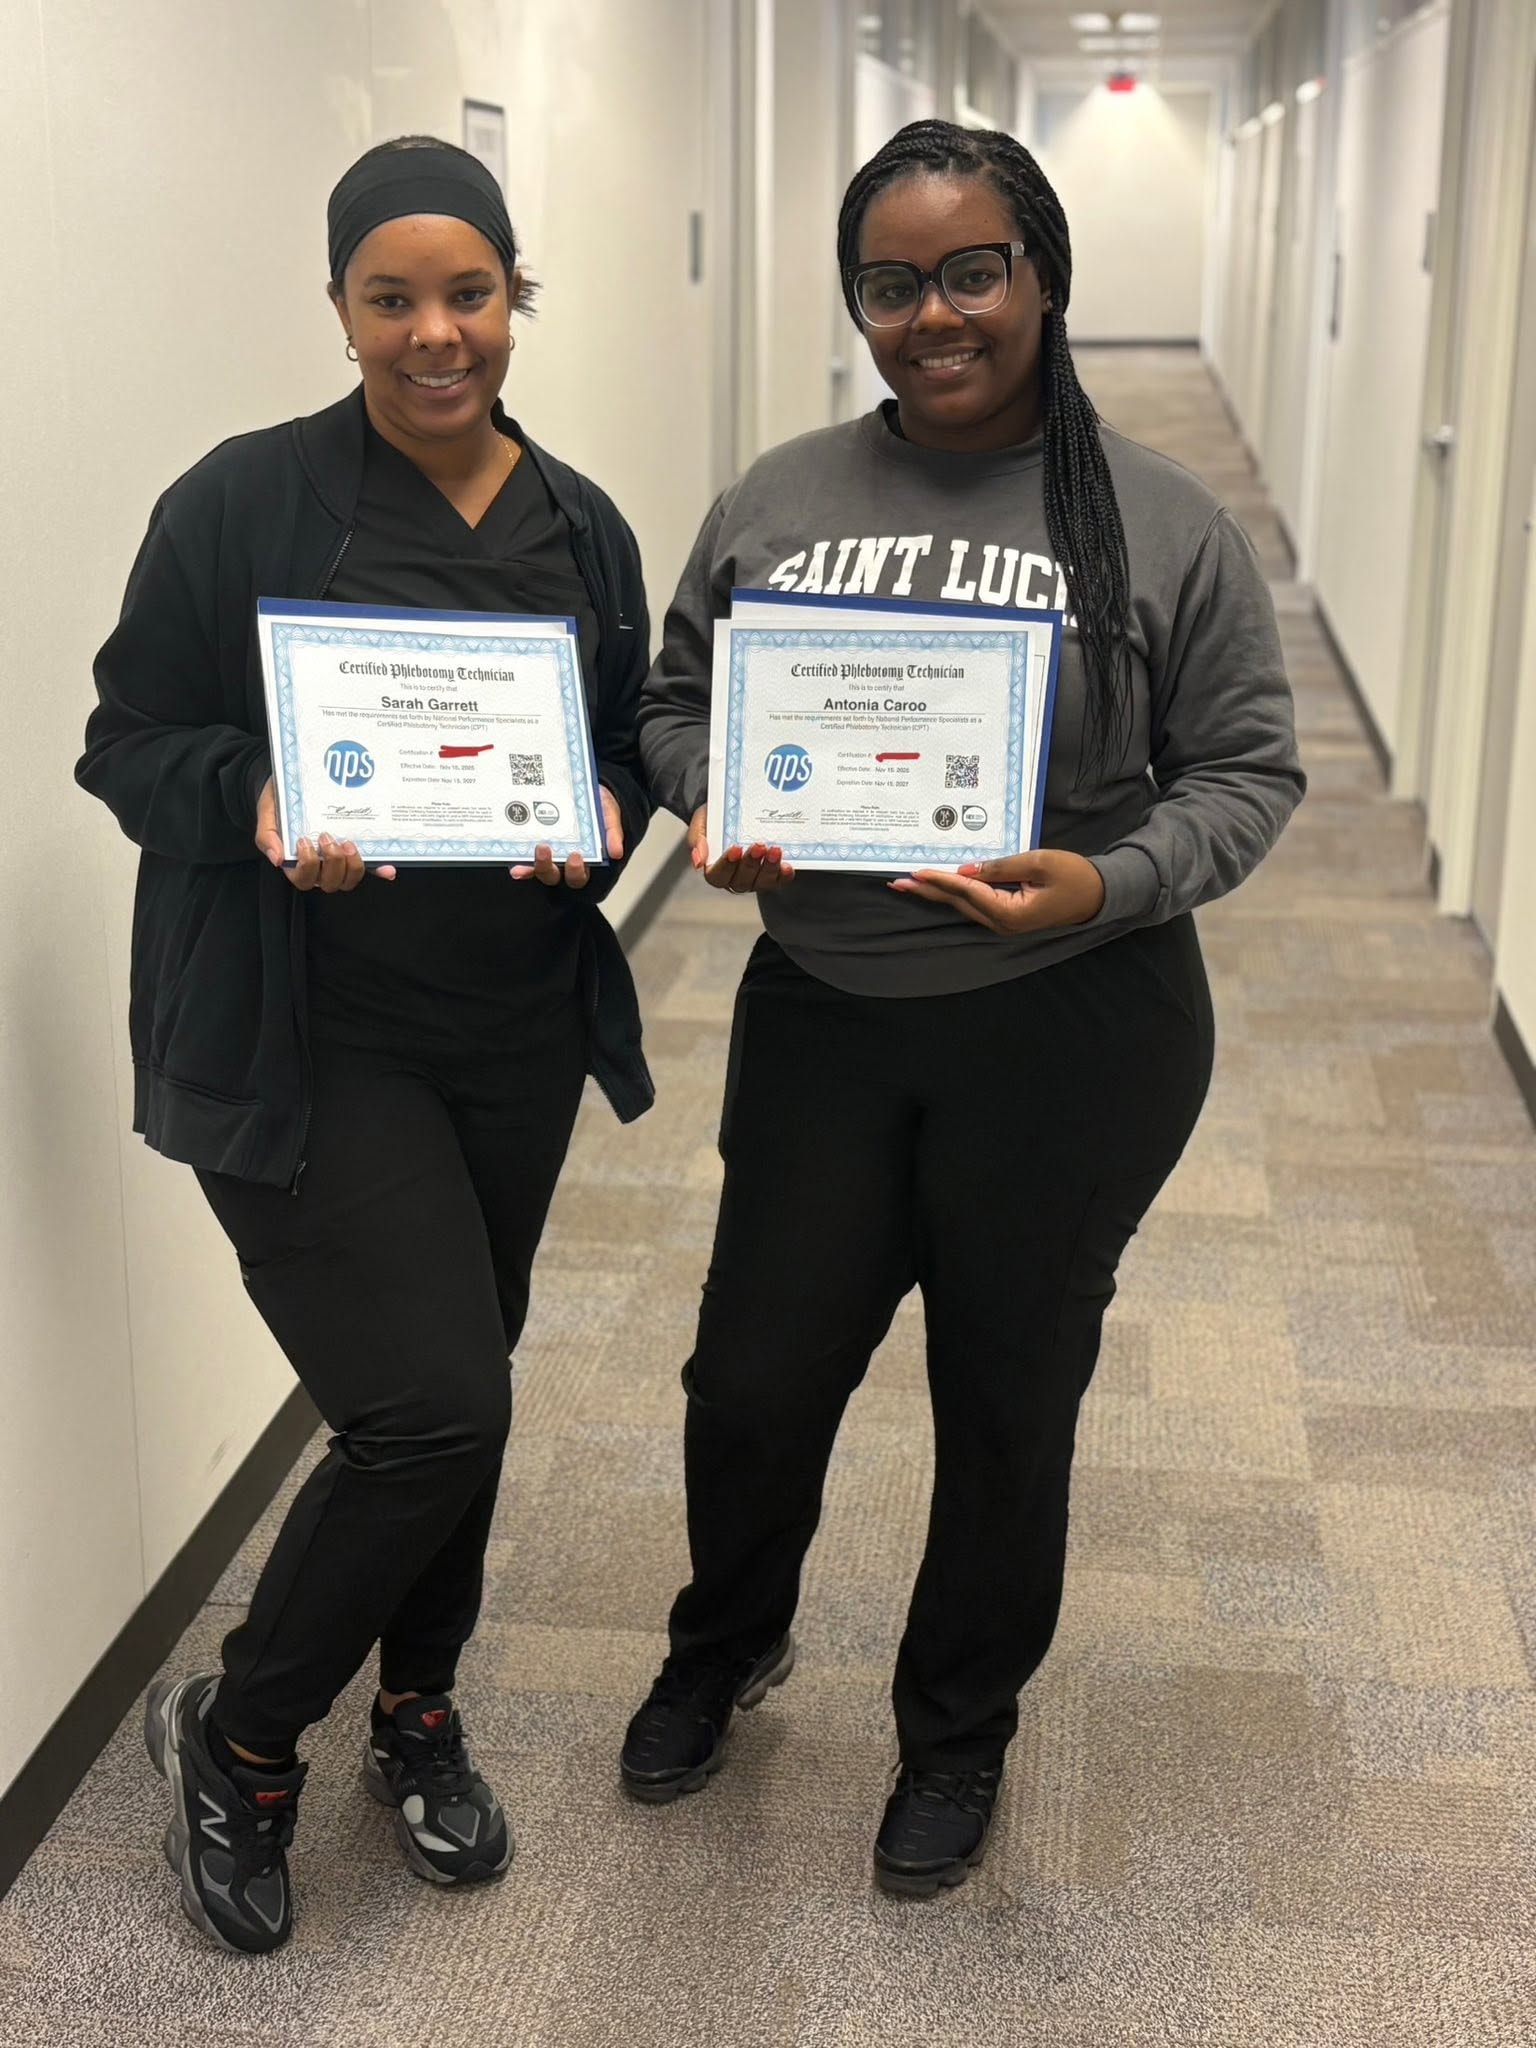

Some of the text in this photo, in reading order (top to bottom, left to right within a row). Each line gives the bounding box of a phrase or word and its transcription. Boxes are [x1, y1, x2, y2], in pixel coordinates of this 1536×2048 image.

[768, 534, 1076, 620] SAINT LUCI
[339, 661, 515, 683] Certified Phlebotomy Technician
[791, 664, 965, 681] Certified Phlebotomy Technician
[874, 684, 892, 692] certify
[381, 696, 479, 712] Sarah Garrett
[823, 699, 927, 712] Antonia Caroo
[326, 749, 374, 788] nps
[765, 752, 813, 791] nps
[198, 1791, 231, 1849] N
